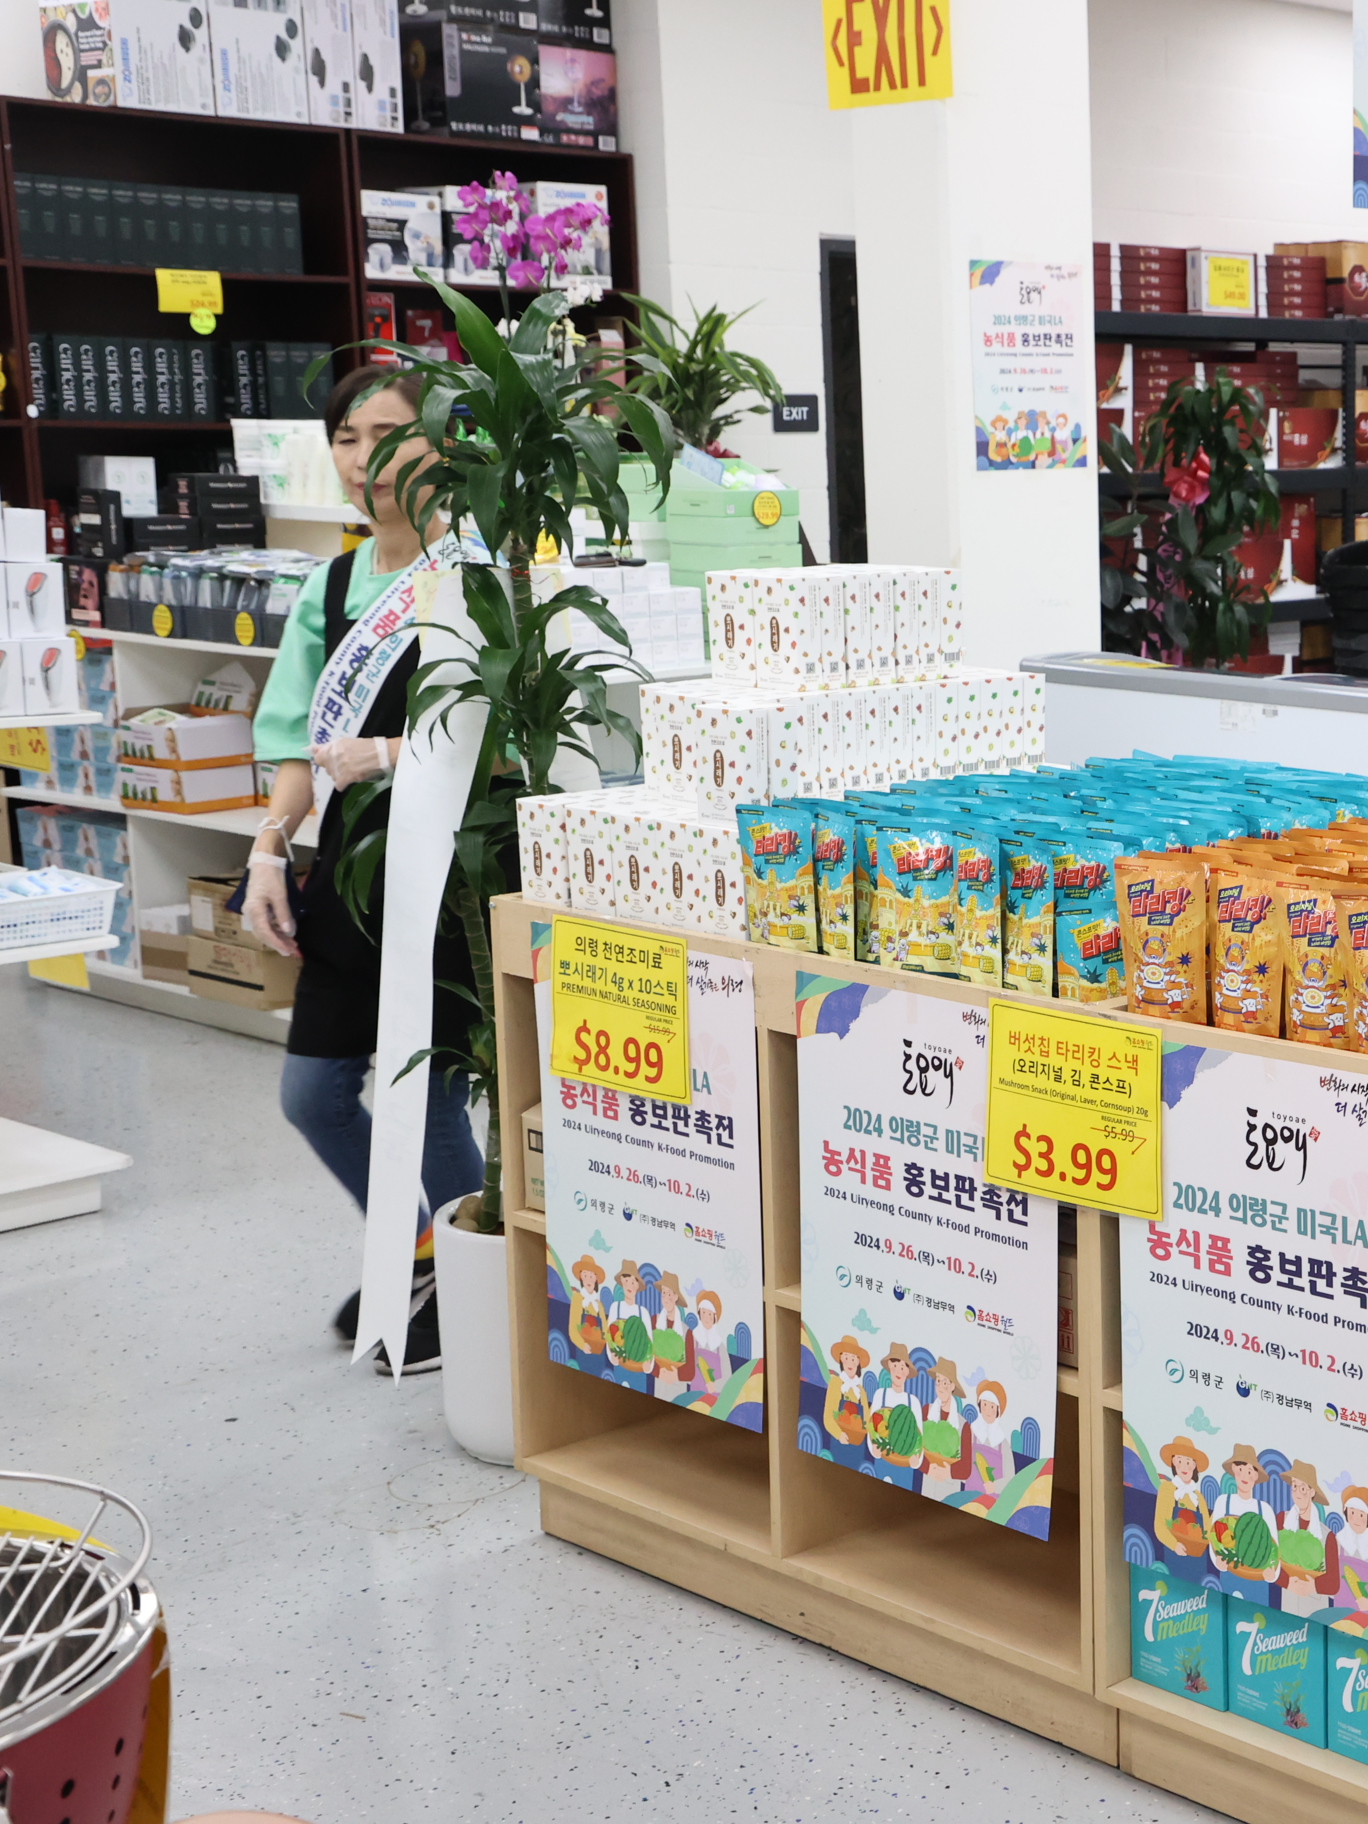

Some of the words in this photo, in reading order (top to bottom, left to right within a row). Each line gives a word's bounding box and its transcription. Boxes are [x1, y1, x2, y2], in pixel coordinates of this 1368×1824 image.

[983, 332, 1017, 348] 농식품
[782, 407, 808, 423] EXIT
[1130, 881, 1152, 893] 오리지널
[1131, 886, 1191, 917] 타리킹!
[1218, 894, 1272, 922] 타리킹!
[1219, 887, 1240, 899] 오리지널
[1289, 901, 1316, 913] 오리지널
[574, 935, 599, 958] 의령
[602, 940, 664, 970] 천연조미료
[559, 958, 608, 987] 뽀시래기
[610, 971, 625, 993] 4g
[627, 980, 634, 991] x
[637, 978, 678, 1002] 10스틱
[561, 981, 598, 998] PREMIUN
[598, 989, 631, 1006] NATURAL
[632, 997, 677, 1016] SEASONING
[573, 1018, 664, 1085] $8.99
[923, 1042, 953, 1055] toyoae
[1008, 1029, 1051, 1060] 버섯칩
[1055, 1039, 1102, 1069] 타리킹
[1106, 1051, 1140, 1076] 스낵
[560, 1077, 620, 1122] 농식품
[998, 1077, 1029, 1093] Mushroom
[1031, 1084, 1048, 1098] Snack
[1049, 1088, 1078, 1106] (Original,
[1080, 1094, 1098, 1109] Laver,
[1099, 1098, 1136, 1116] Cornsoup)
[1136, 1105, 1149, 1118] 20g
[1012, 1057, 1067, 1089] (오리지널,
[1070, 1068, 1086, 1091] 김,
[1088, 1071, 1133, 1099] 콘스프)
[843, 1105, 883, 1138] 2024
[888, 1116, 939, 1153] 의령군
[1101, 1115, 1125, 1125] REGULAR
[1125, 1119, 1138, 1128] PRICE
[1103, 1124, 1136, 1143] $5.99
[1271, 1110, 1307, 1126] toyoae
[562, 1118, 582, 1132] 2024
[584, 1124, 622, 1144] Uiryeong
[625, 1134, 655, 1151] County
[657, 1142, 687, 1158] K-Food
[689, 1150, 735, 1171] Promotion
[821, 1140, 893, 1192] 농식품
[1012, 1122, 1118, 1192] $3.99
[823, 1186, 847, 1201] 2024
[850, 1192, 895, 1216] Uiryeong
[898, 1206, 933, 1226] County
[936, 1216, 970, 1235] K-Food
[974, 1226, 1029, 1251] Promotion
[1172, 1181, 1222, 1219] 2024
[1228, 1192, 1290, 1234] 의령군
[1147, 1220, 1234, 1278] 농식품
[1149, 1270, 1178, 1289] 2024
[1182, 1278, 1236, 1304] Uiryeong
[1240, 1293, 1283, 1316] County
[1287, 1304, 1329, 1325] K-Food
[1138, 1588, 1161, 1643] 7
[1156, 1589, 1209, 1621] Seaweed
[1235, 1621, 1260, 1676] 7
[1254, 1622, 1308, 1655] Seaweed
[1335, 1656, 1361, 1713] 7
